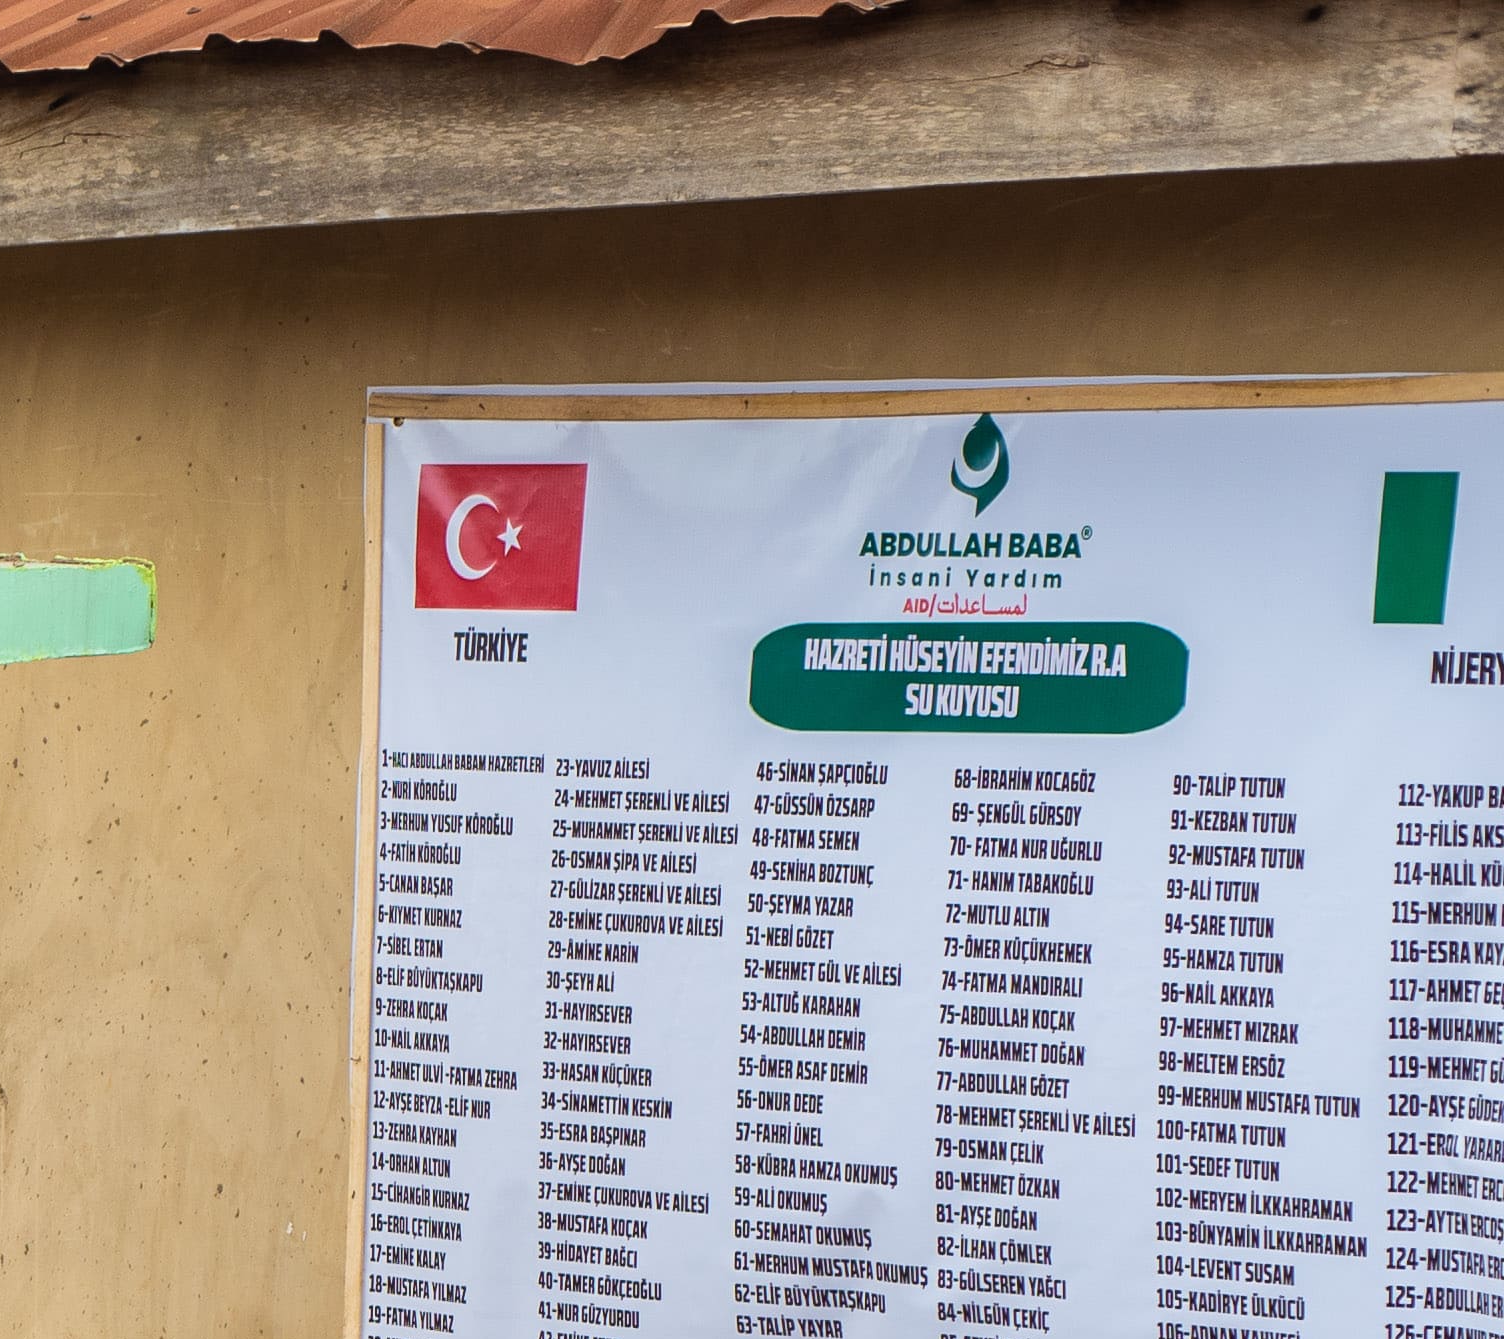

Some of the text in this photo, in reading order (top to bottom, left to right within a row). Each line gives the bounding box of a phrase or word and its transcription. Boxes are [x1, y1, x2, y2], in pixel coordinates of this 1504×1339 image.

[859, 531, 1002, 558] ABDULLAH
[870, 564, 1062, 588] İnsani Yardım
[454, 627, 528, 662] TÜRKİYE
[804, 633, 888, 671] HAZRETİ
[889, 635, 977, 674] HÜSEYİN
[982, 636, 1088, 676] EFENDİMİZ
[905, 683, 1020, 718] SU KUYUSU
[556, 758, 611, 778] 23-YAVUZ
[1240, 777, 1285, 798] TUTUN
[1399, 784, 1484, 808] 112-YAKUP
[555, 788, 622, 809] 24-MEHMET
[675, 793, 689, 812] VE
[952, 802, 974, 822] 69-
[752, 827, 859, 851] 48-FATMA SEMEN
[951, 836, 971, 856] 70-
[975, 837, 1017, 858] FATMA
[1021, 838, 1047, 860] NUR
[552, 849, 611, 870] 26-OSMAN
[643, 853, 657, 872] VE
[1169, 844, 1304, 870] 92-MUSTAFA TUTUN
[948, 869, 968, 890] 71-
[972, 870, 1015, 893] HANIM
[744, 958, 815, 981] 52-MEHMET
[845, 963, 860, 984] VE
[1163, 948, 1283, 974] 95-HAMZA TUTUN
[1390, 978, 1481, 1003] 117-AHMET
[545, 1001, 632, 1024] 31-HAYIRSEVER
[1161, 1016, 1298, 1044] 97-MEHMET MIZRAK
[938, 1037, 1037, 1063] 76-MUHAMMET
[543, 1061, 599, 1082] 33-HASAN
[796, 1060, 827, 1082] ASAF
[1158, 1085, 1360, 1118] 99-MERHUM MUSTAFA TUTUN
[540, 1121, 587, 1142] 35-ESRA
[800, 1159, 841, 1181] HAMZA
[1157, 1153, 1279, 1182] 101-SEDEF TUTUN
[936, 1170, 1015, 1195] 80-MEHMET
[538, 1211, 608, 1235] 38-MUSTAFA
[539, 1271, 595, 1294] 40-TAMER
[1157, 1255, 1294, 1286] 104-LEVENT SUSAM
[798, 1318, 843, 1339] YAYAR
